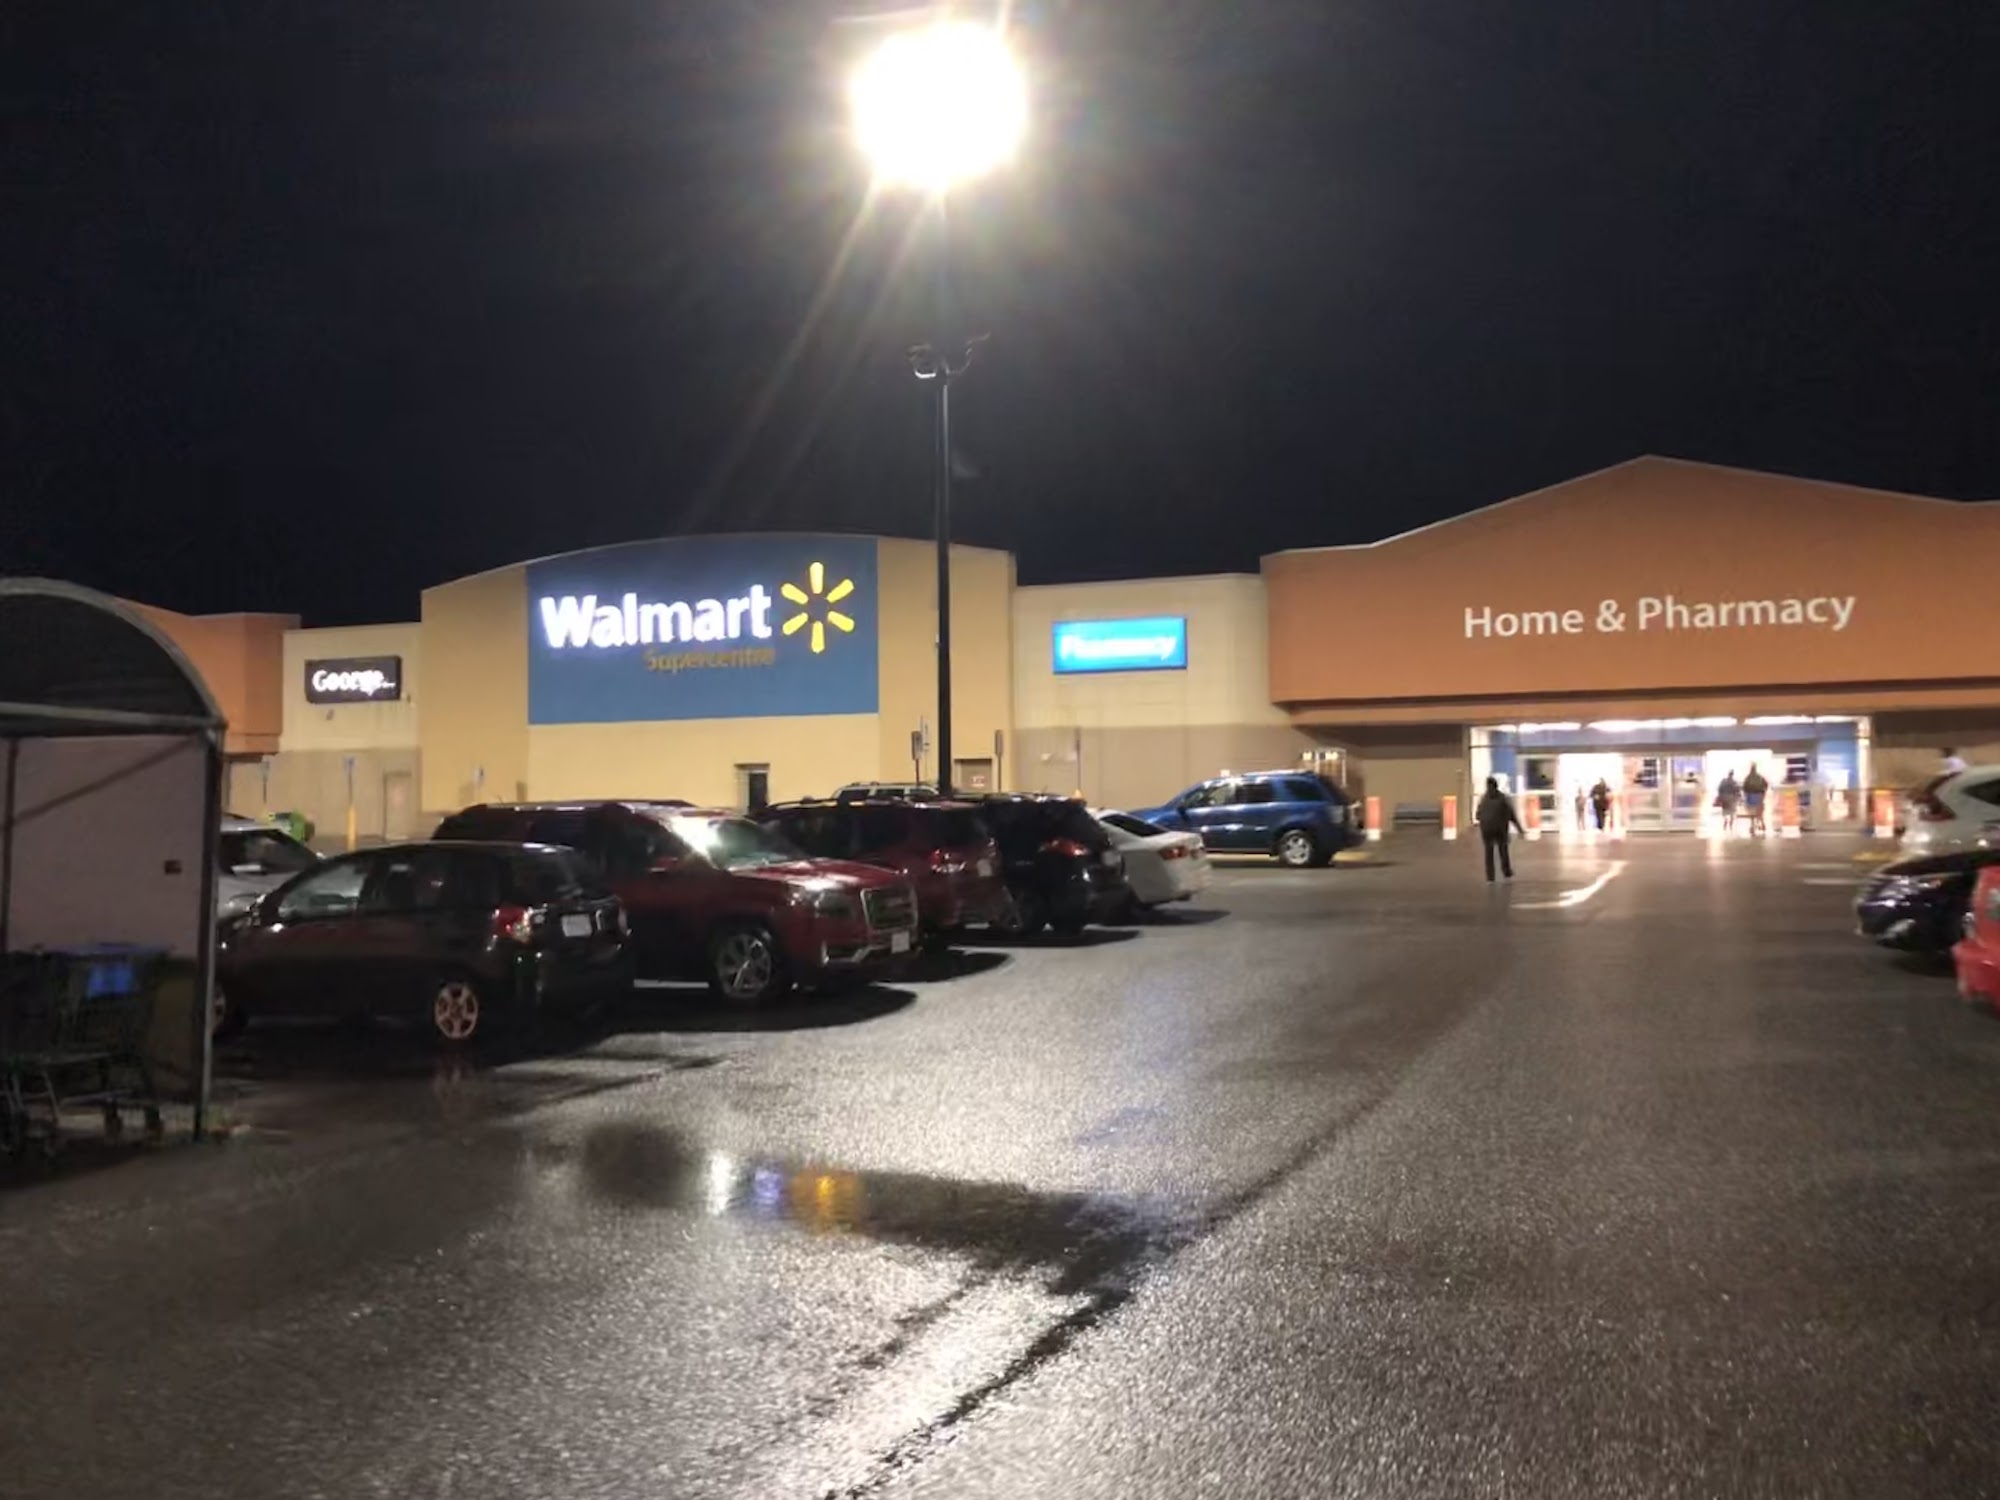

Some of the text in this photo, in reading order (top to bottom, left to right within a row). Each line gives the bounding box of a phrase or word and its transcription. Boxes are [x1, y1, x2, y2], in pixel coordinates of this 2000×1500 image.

[539, 583, 773, 648] Walmart
[1463, 593, 1857, 639] Home & Pharmacy
